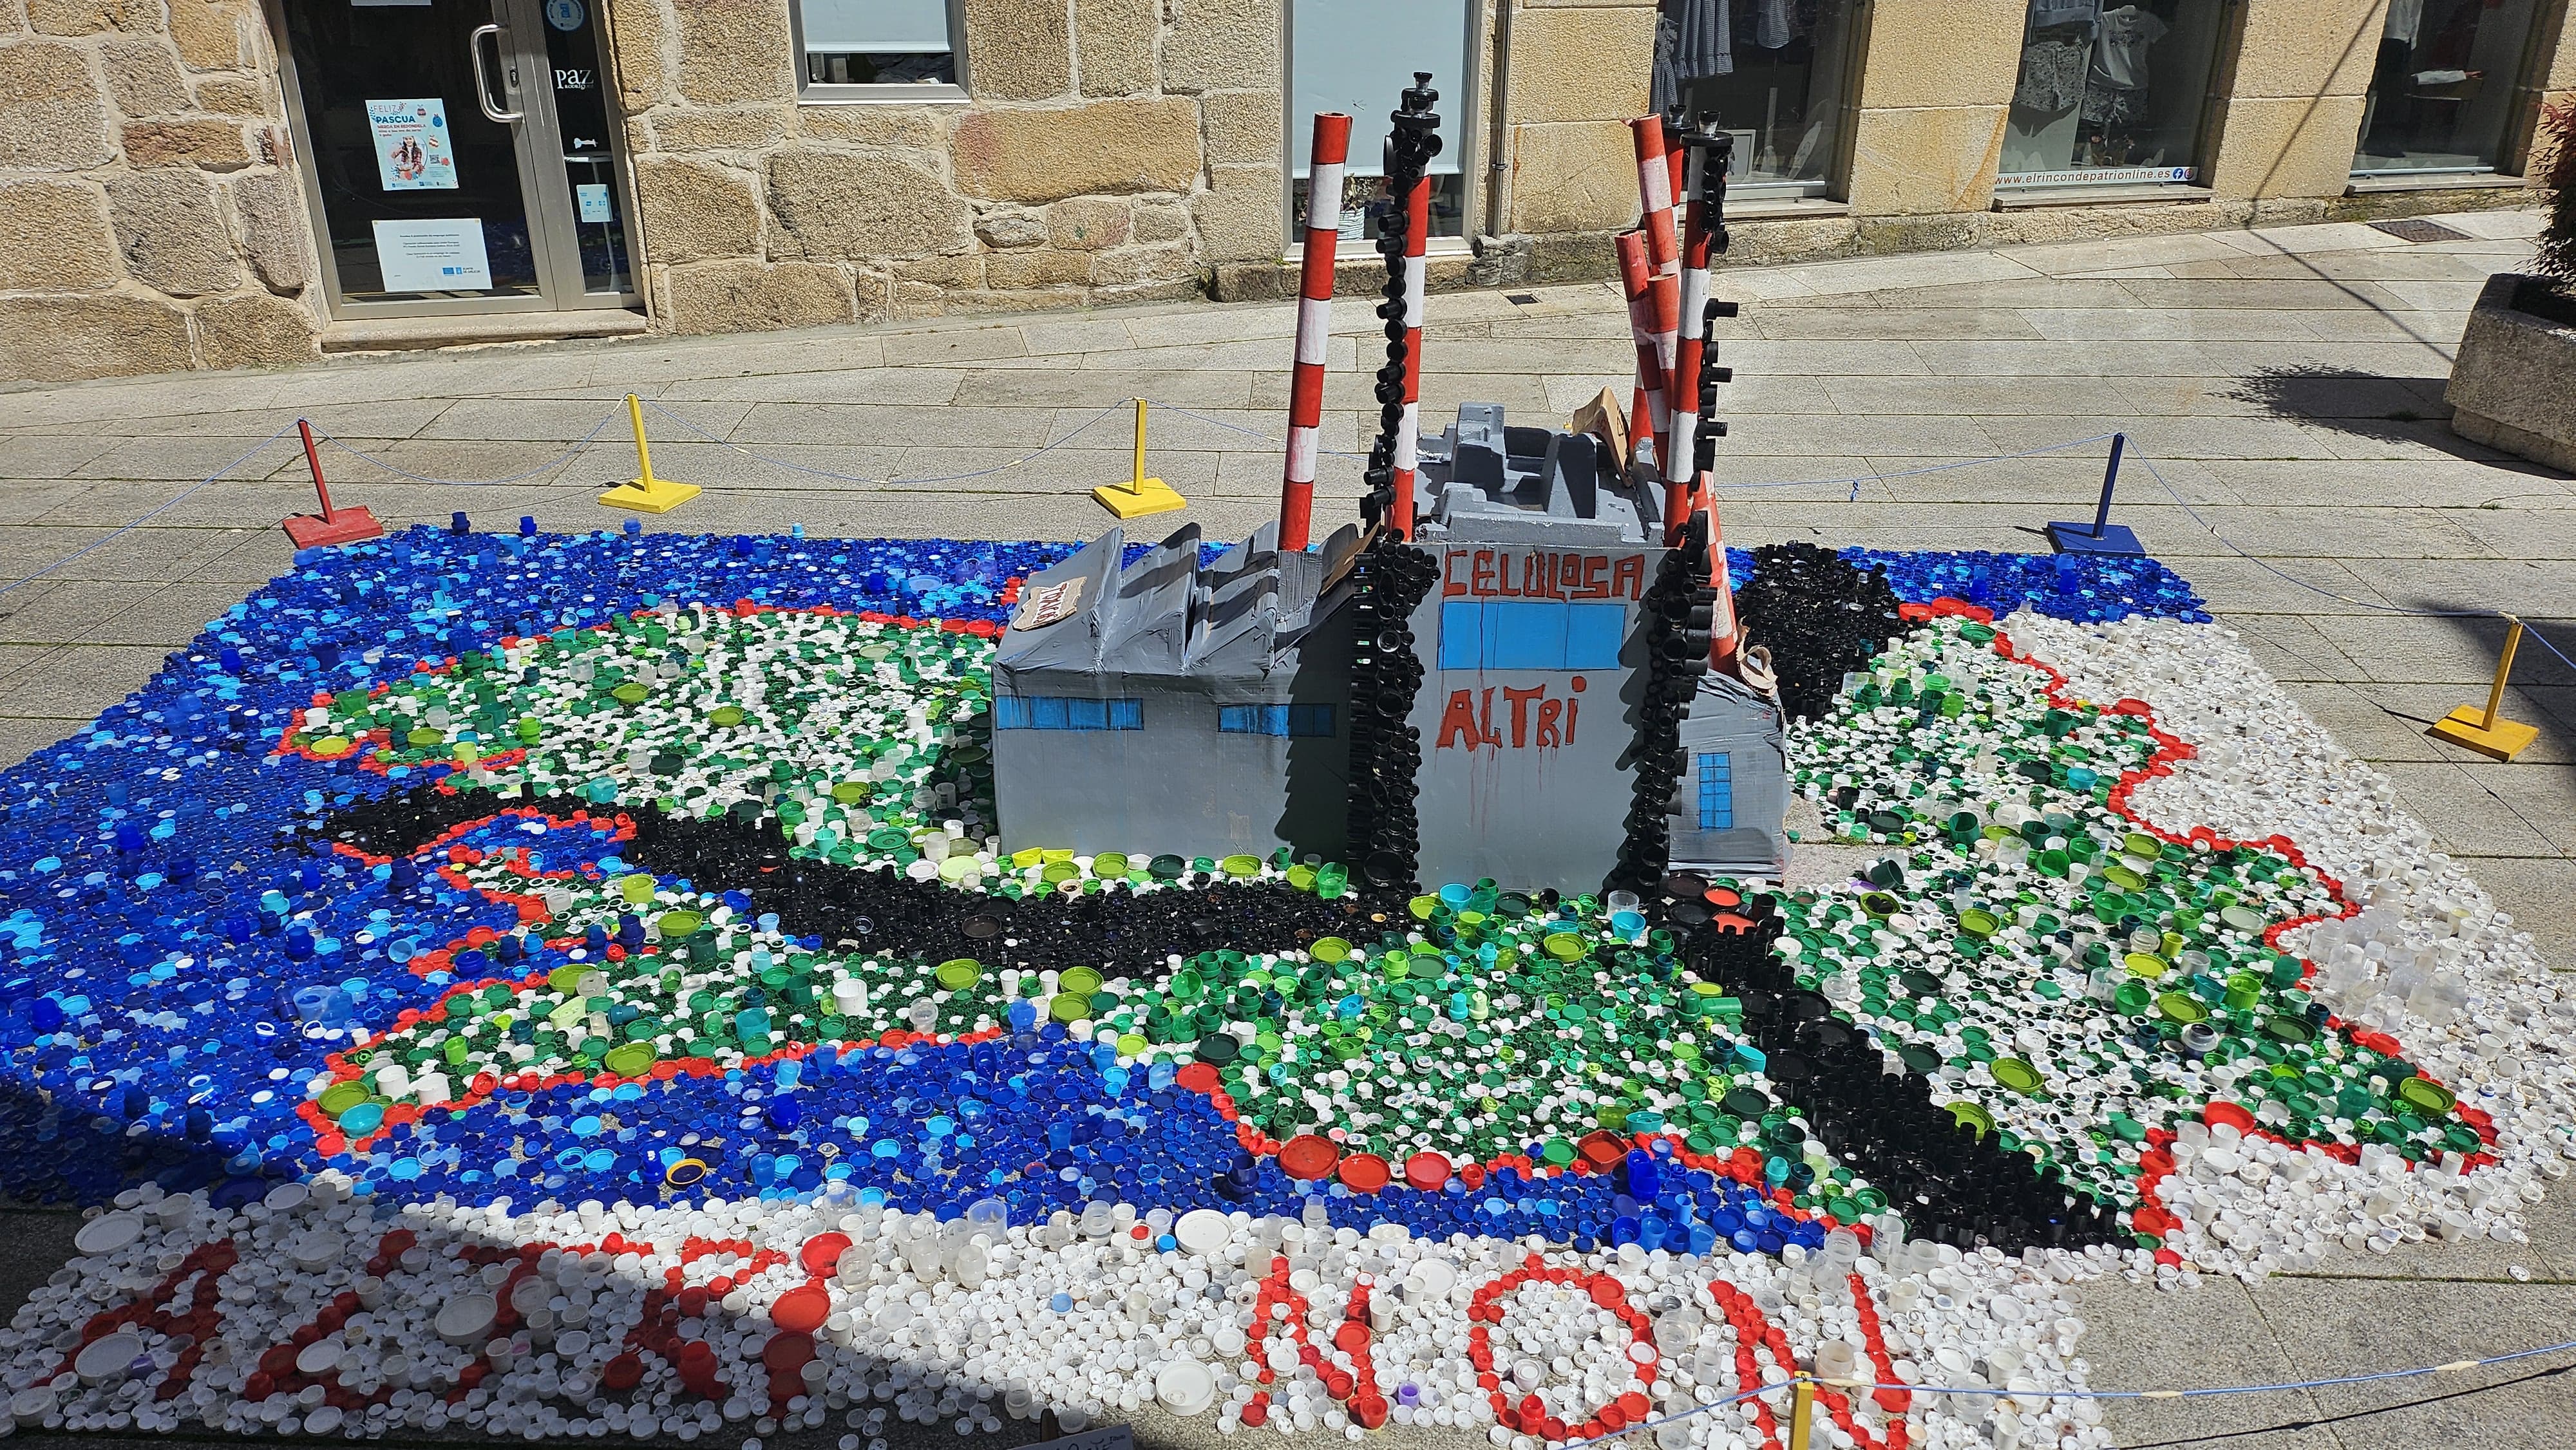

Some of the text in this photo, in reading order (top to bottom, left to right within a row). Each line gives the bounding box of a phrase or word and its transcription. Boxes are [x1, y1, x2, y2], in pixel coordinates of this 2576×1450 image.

[374, 104, 397, 113] FELIZ
[376, 115, 416, 124] PASCUA
[1995, 169, 2170, 184] www.elrincondepatrionline.es
[1443, 549, 1645, 602] CELULOSA
[1242, 1253, 1913, 1450] NON
